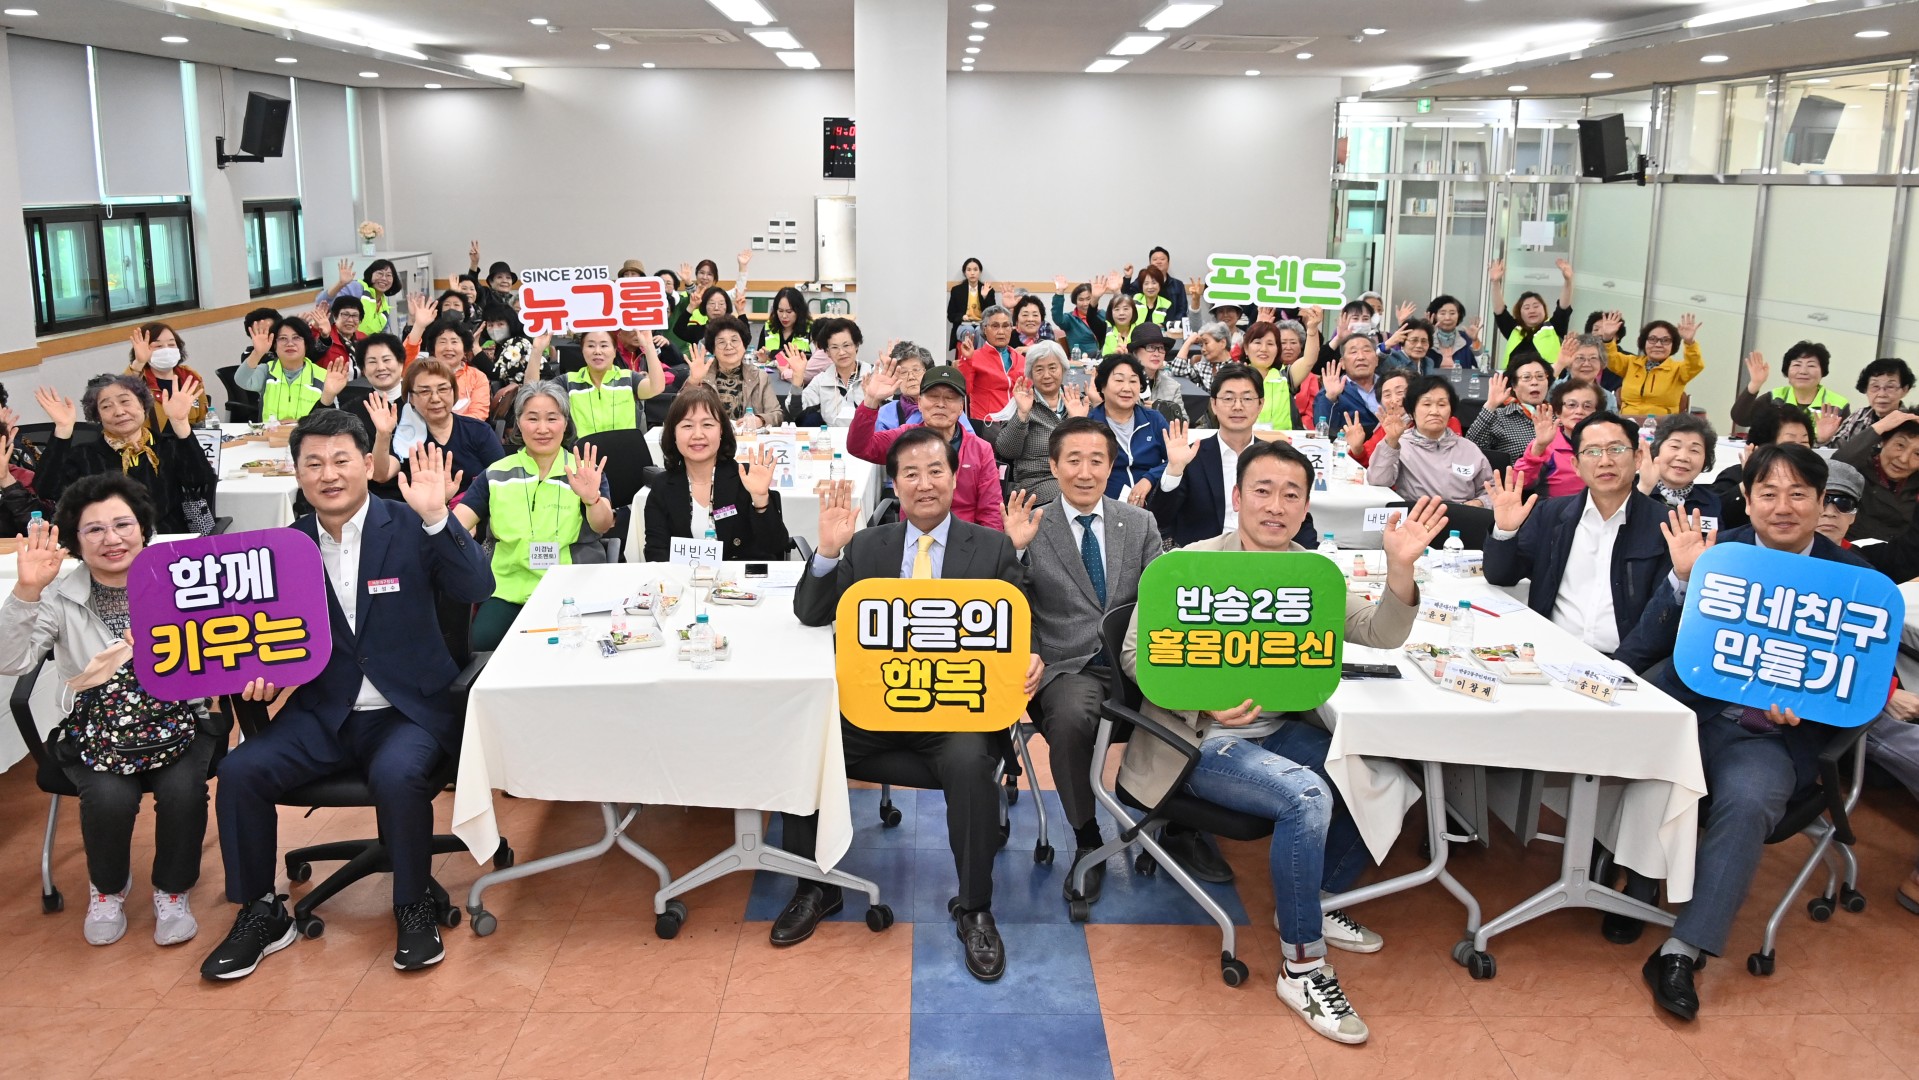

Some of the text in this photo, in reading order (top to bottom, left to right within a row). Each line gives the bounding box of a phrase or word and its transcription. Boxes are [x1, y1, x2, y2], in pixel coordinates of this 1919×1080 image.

[522, 267, 608, 283] SINCE 2015
[1208, 257, 1342, 306] 프렌드
[523, 281, 664, 332] 뉴그룹
[674, 543, 717, 560] 내빈석
[168, 547, 276, 609] 함께
[859, 598, 1010, 651] 마을의
[1177, 586, 1311, 623] 반송2동
[1699, 573, 1888, 648] 동네친구
[151, 611, 308, 674] 키우는
[1148, 629, 1333, 666] 홀몸어르신
[1713, 629, 1856, 698] 만들기
[881, 658, 984, 711] 행복
[1580, 680, 1610, 698] 송민우
